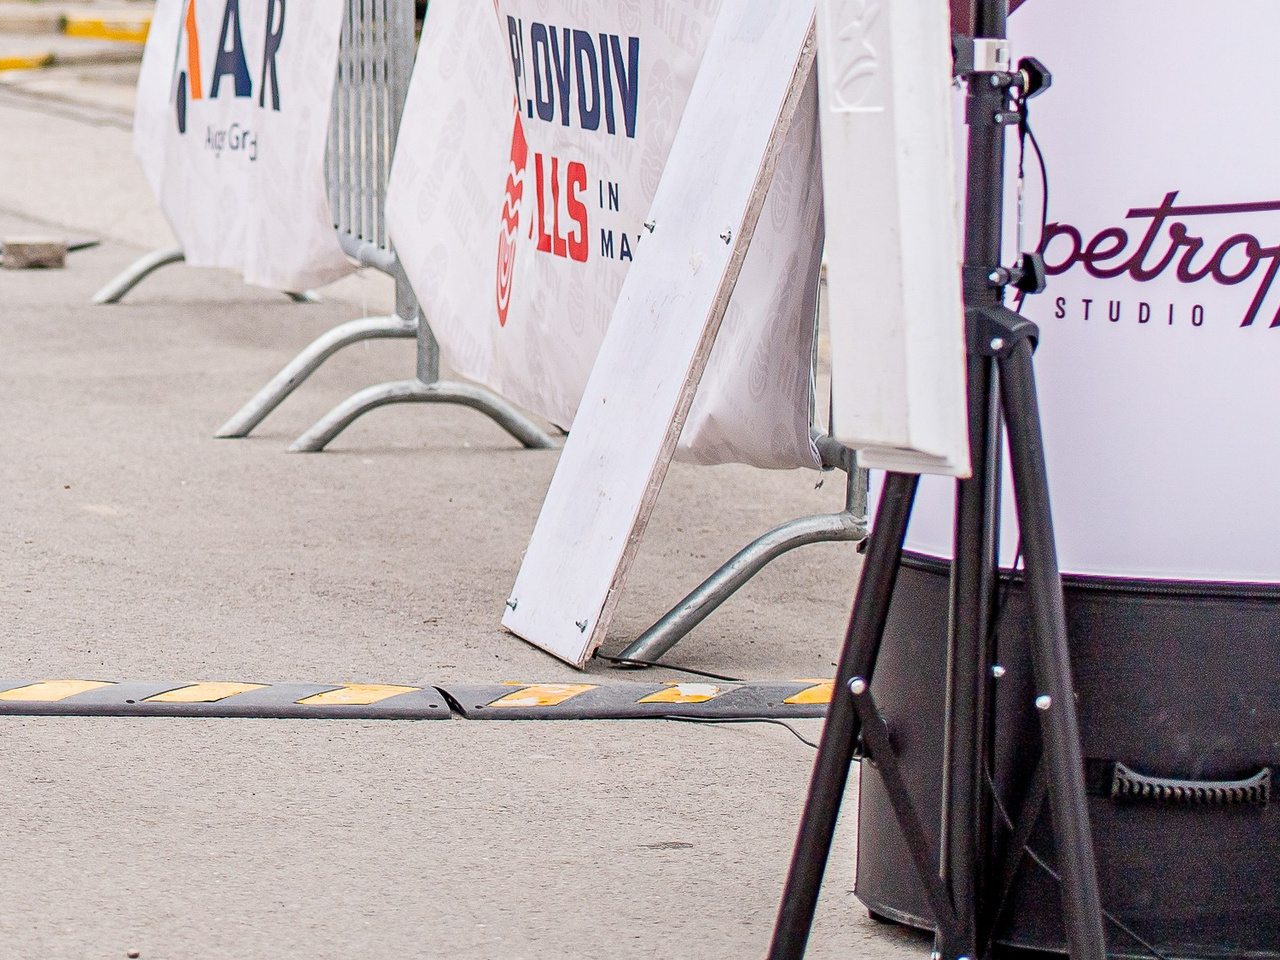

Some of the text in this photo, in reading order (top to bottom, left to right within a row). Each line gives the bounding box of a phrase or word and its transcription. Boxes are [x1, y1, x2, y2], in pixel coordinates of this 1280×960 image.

[599, 179, 620, 212] IN
[601, 228, 641, 262] MA
[1055, 296, 1205, 328] STUDIO
